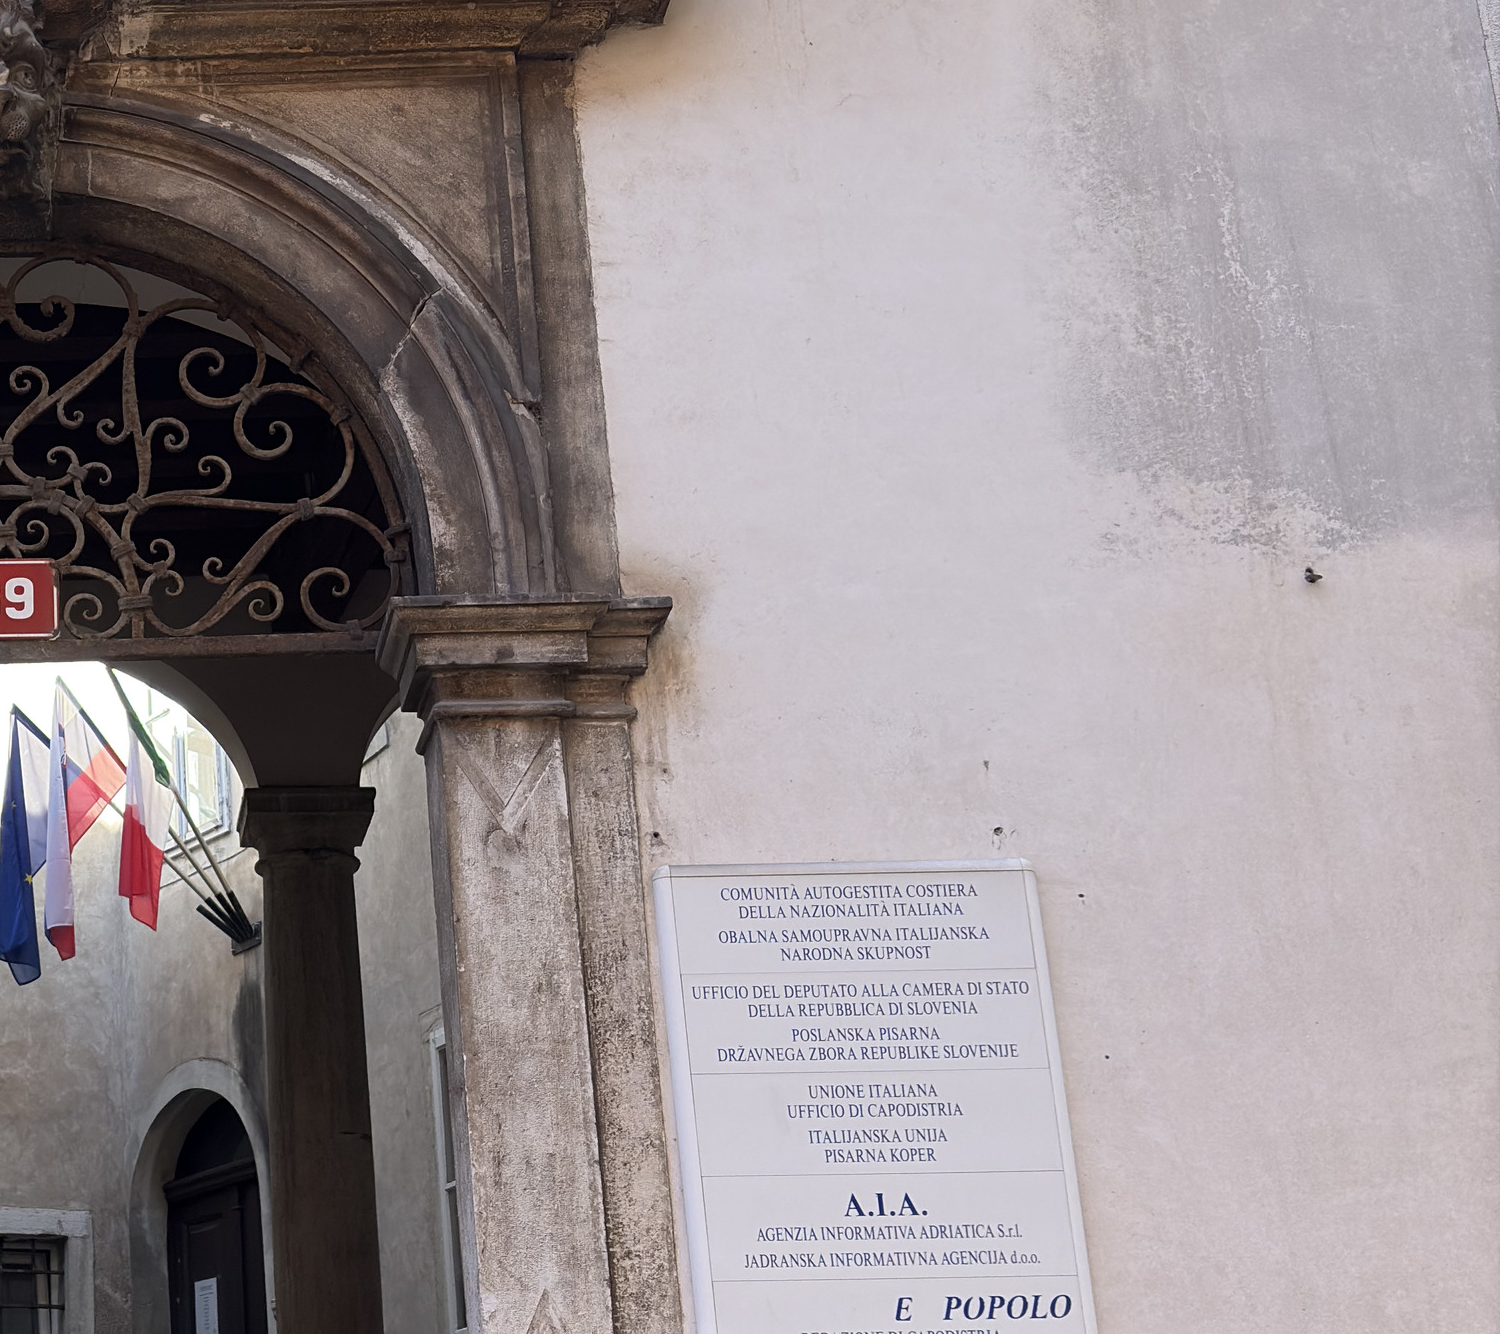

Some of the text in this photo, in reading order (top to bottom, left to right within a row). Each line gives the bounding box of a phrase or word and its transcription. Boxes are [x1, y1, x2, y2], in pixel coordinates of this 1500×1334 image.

[721, 884, 978, 901] COMUNITÀ AUTOGESTITA COSTIERA
[739, 900, 964, 919] DELLA NAZIONALITÀ ITALIANA
[719, 927, 989, 943] OBALNA SAMOUPRAVNA ITALIJANSKA
[780, 946, 931, 961] NARODNA SKUPNOST
[692, 981, 1029, 999] UFFICIO DEL DEPUTATO ALLA CAMERA DI STATO
[748, 1001, 978, 1017] DELLA REPUBBLICA DI SLOVENIA
[792, 1027, 940, 1042] POSLANSKA PISARNA
[718, 1043, 1018, 1061] DRŽAVNEGA ZBORA REPUBLIKE SLOVENIJE
[808, 1084, 938, 1099] UNIONE ITALIANA
[787, 1103, 963, 1118] UFFICIO DI CAPODISTRIA
[808, 1129, 947, 1144] ITALIJANSKA UNIJA
[825, 1148, 937, 1163] PISARNA KOPER
[844, 1193, 928, 1217] A.I.A.
[757, 1224, 1022, 1241] AGENZIA INFORMATIVA ADRIATICA S.r.l.
[745, 1251, 1041, 1268] JADRANSKA INFORMATIVNA AGENCIJA d.o.o.
